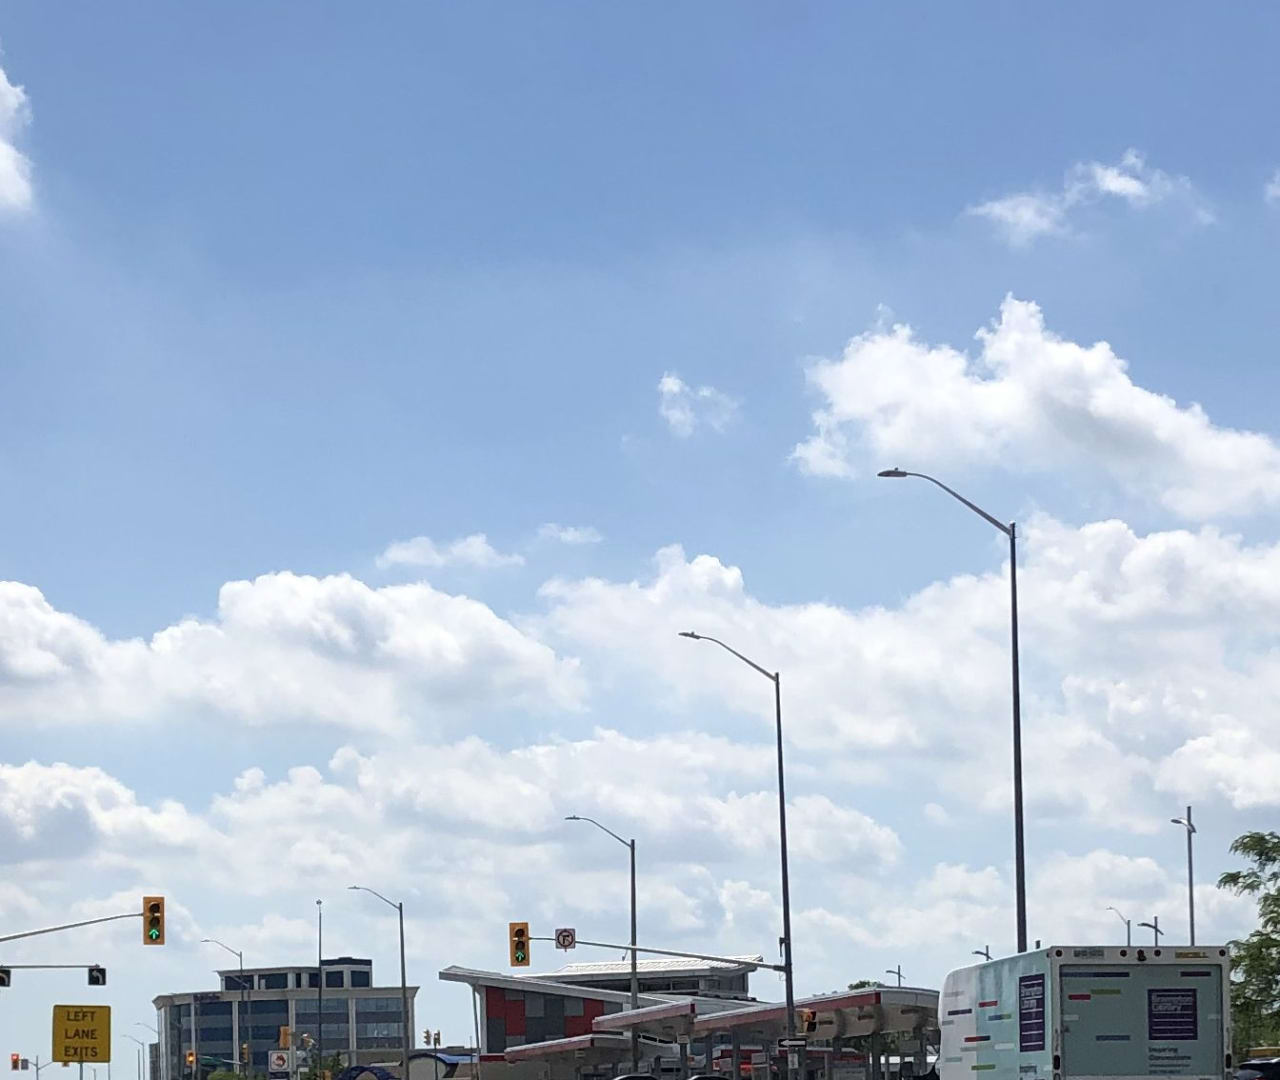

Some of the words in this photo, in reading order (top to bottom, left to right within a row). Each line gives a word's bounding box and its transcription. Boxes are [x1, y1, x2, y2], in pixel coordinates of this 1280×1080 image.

[66, 1010, 96, 1022] LEFT
[64, 1028, 98, 1040] LANE
[64, 1045, 98, 1057] EXITS
